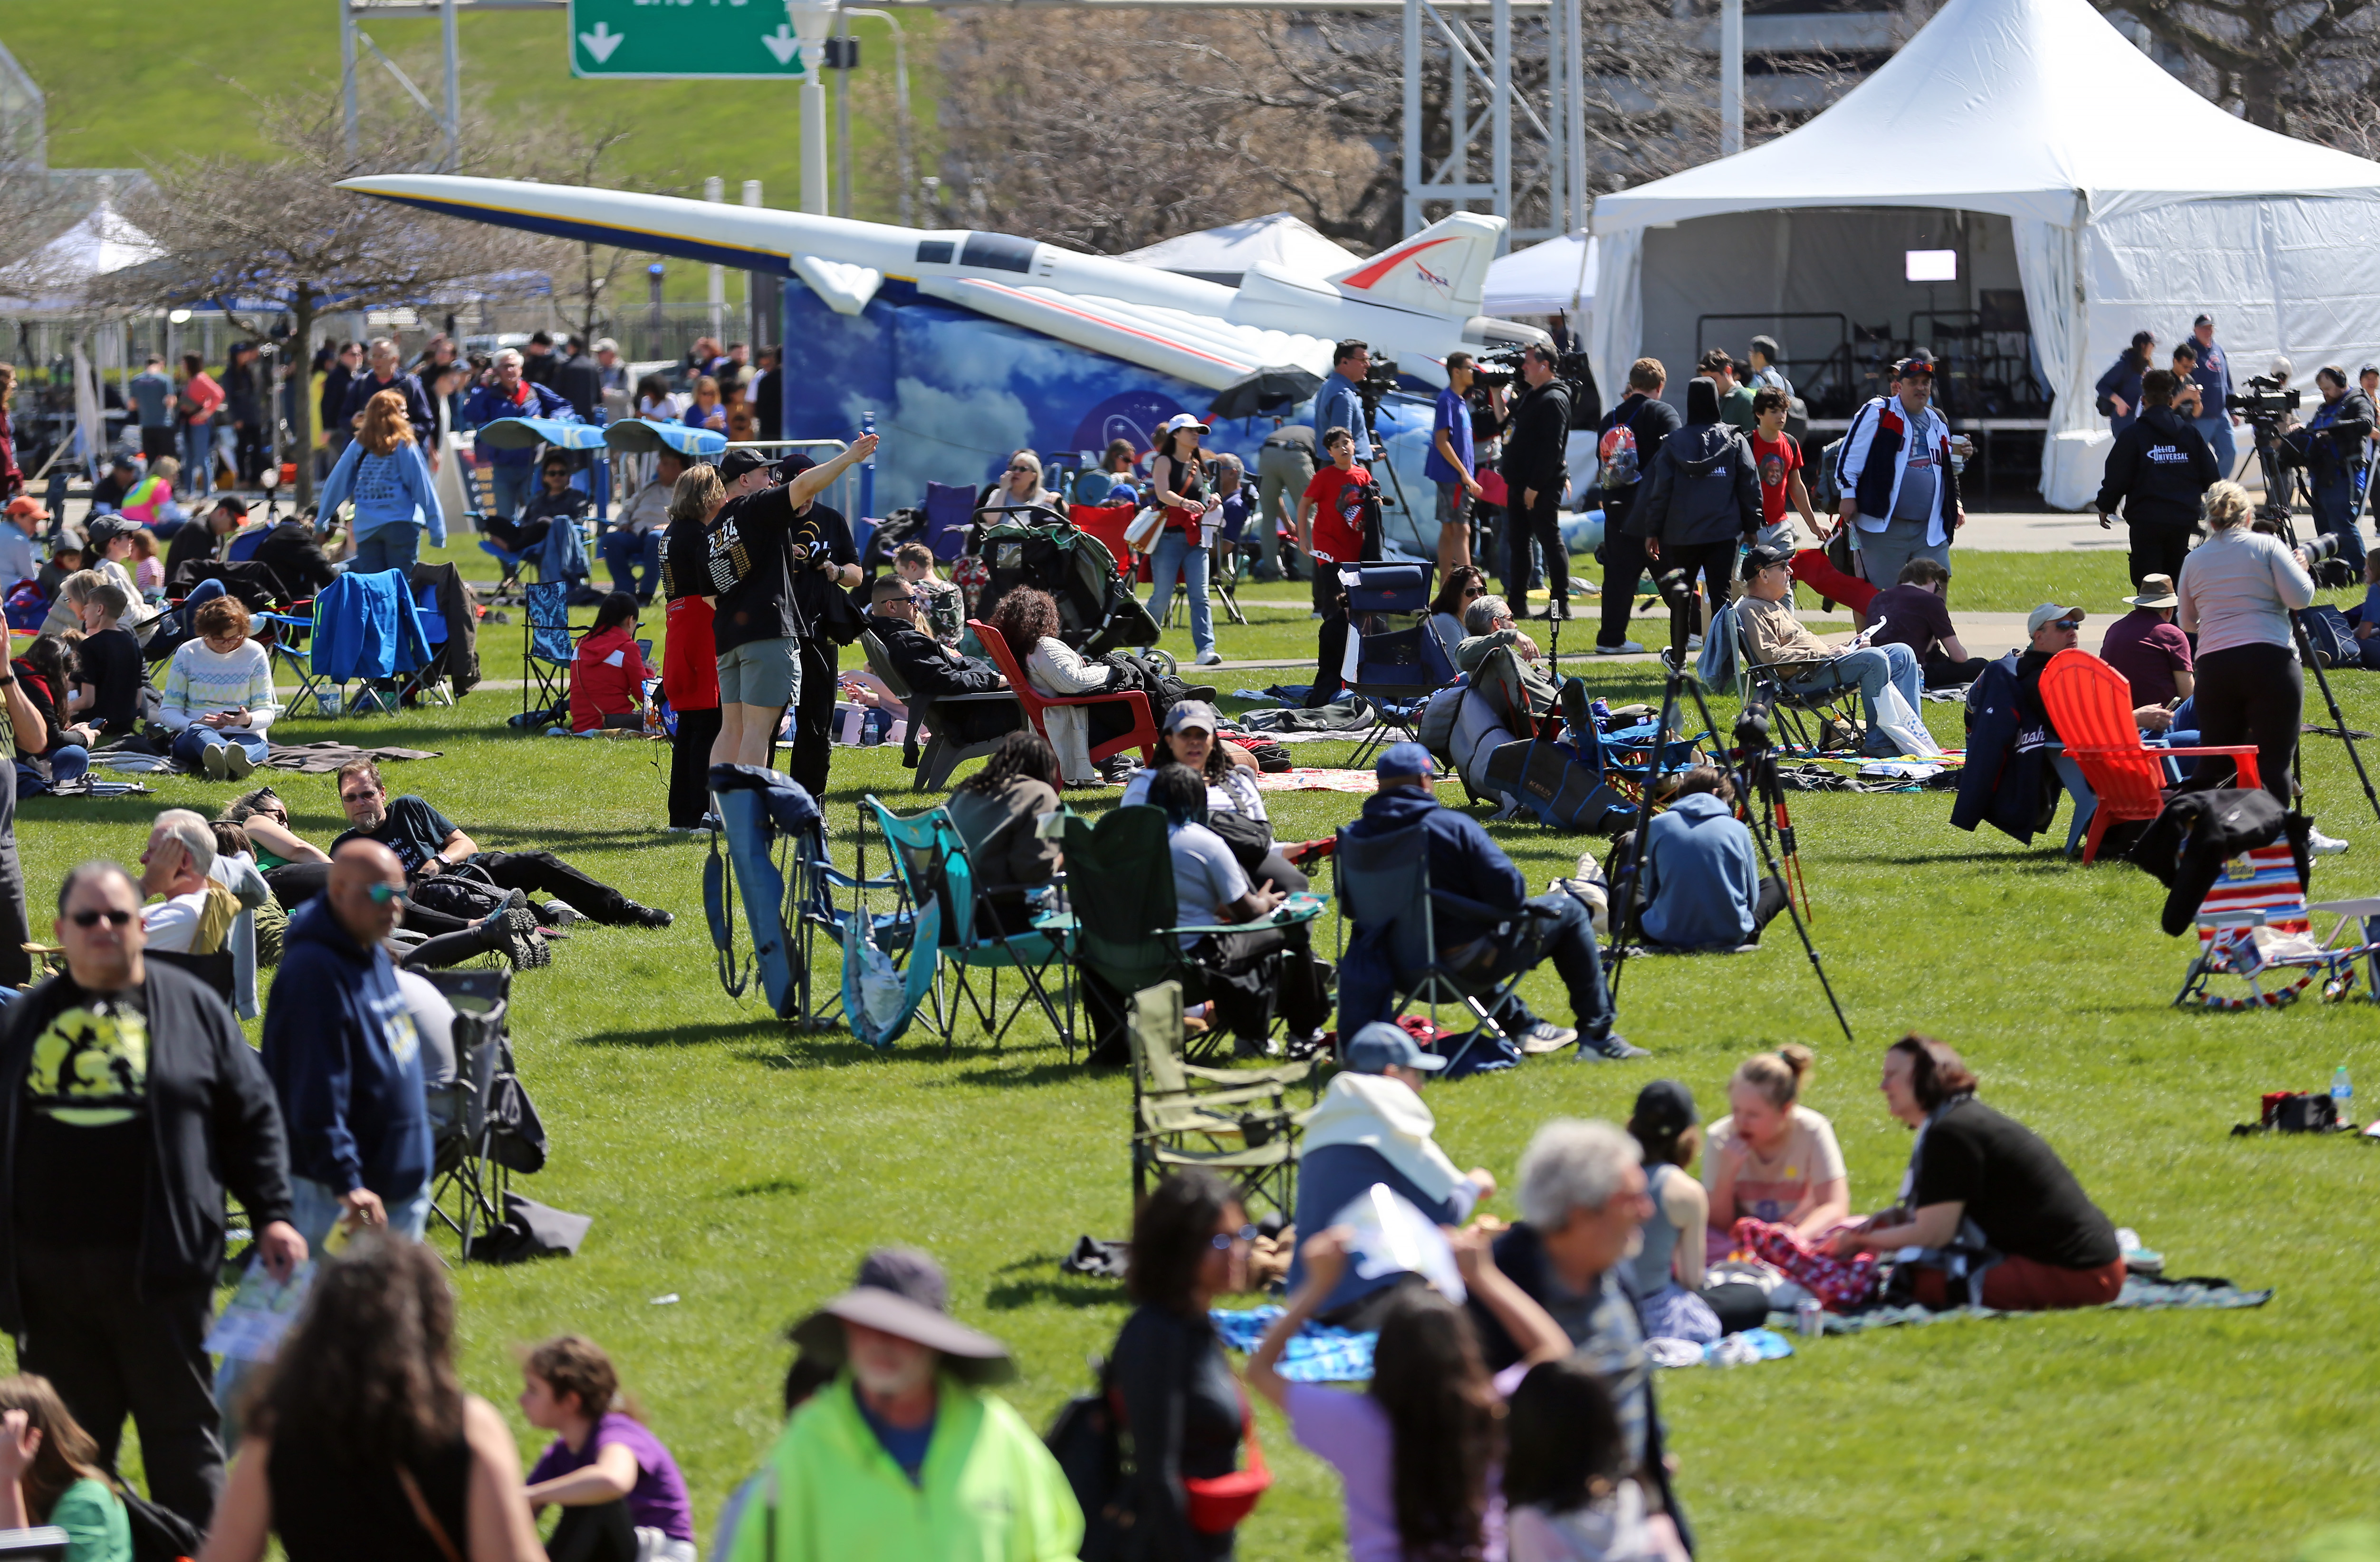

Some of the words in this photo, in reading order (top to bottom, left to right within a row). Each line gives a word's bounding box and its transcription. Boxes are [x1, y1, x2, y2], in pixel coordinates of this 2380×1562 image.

[2154, 444, 2176, 453] ALLIED
[2154, 450, 2188, 461] UNIVERSAL
[709, 520, 738, 554] 2024
